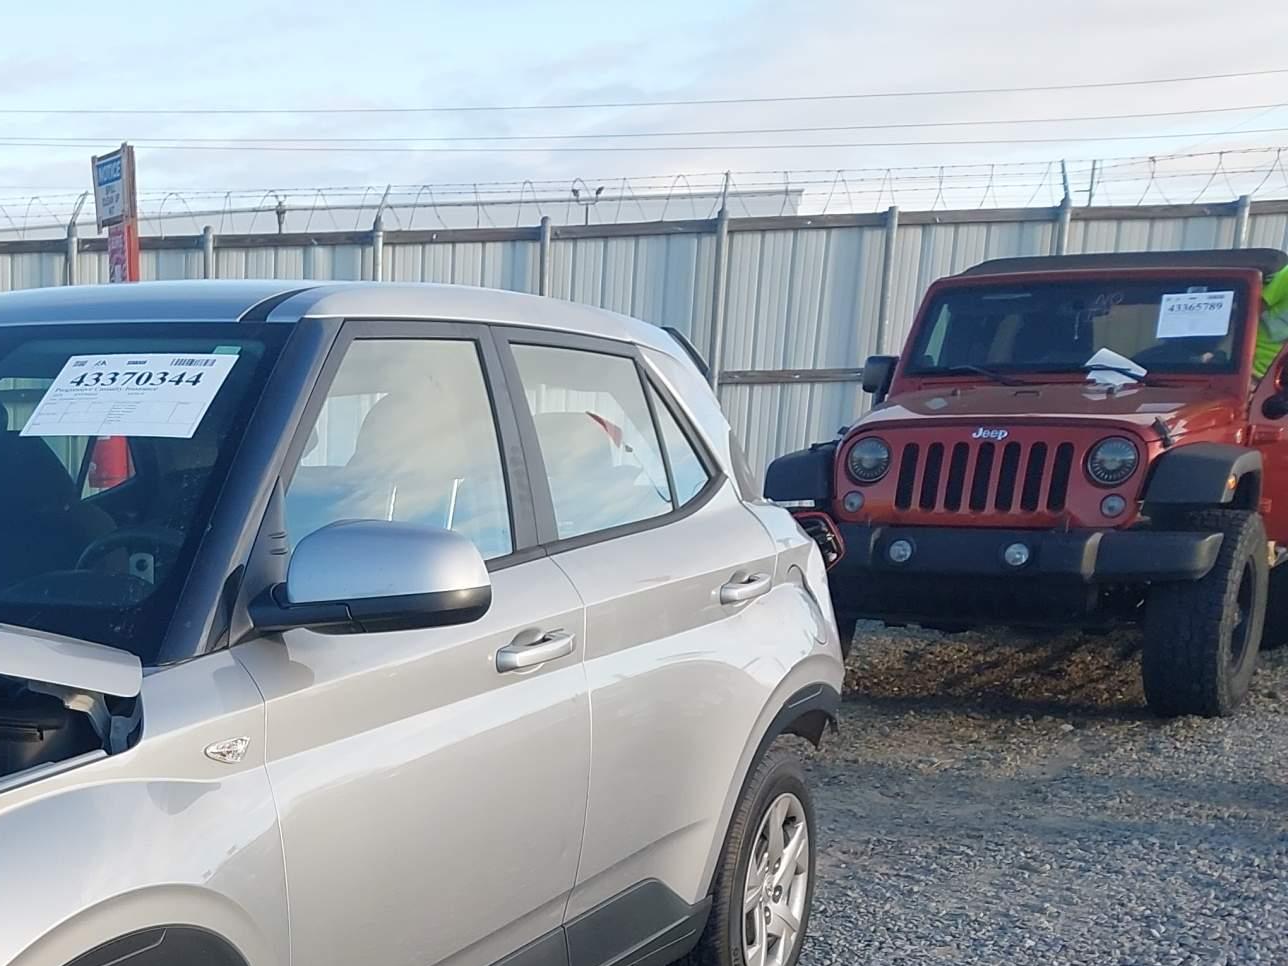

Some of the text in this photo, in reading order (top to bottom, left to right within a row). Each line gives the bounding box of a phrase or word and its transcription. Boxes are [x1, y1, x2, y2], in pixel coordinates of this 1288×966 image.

[1168, 303, 1223, 312] 43365789
[70, 371, 204, 386] 43370344
[972, 427, 1008, 440] Jeep
